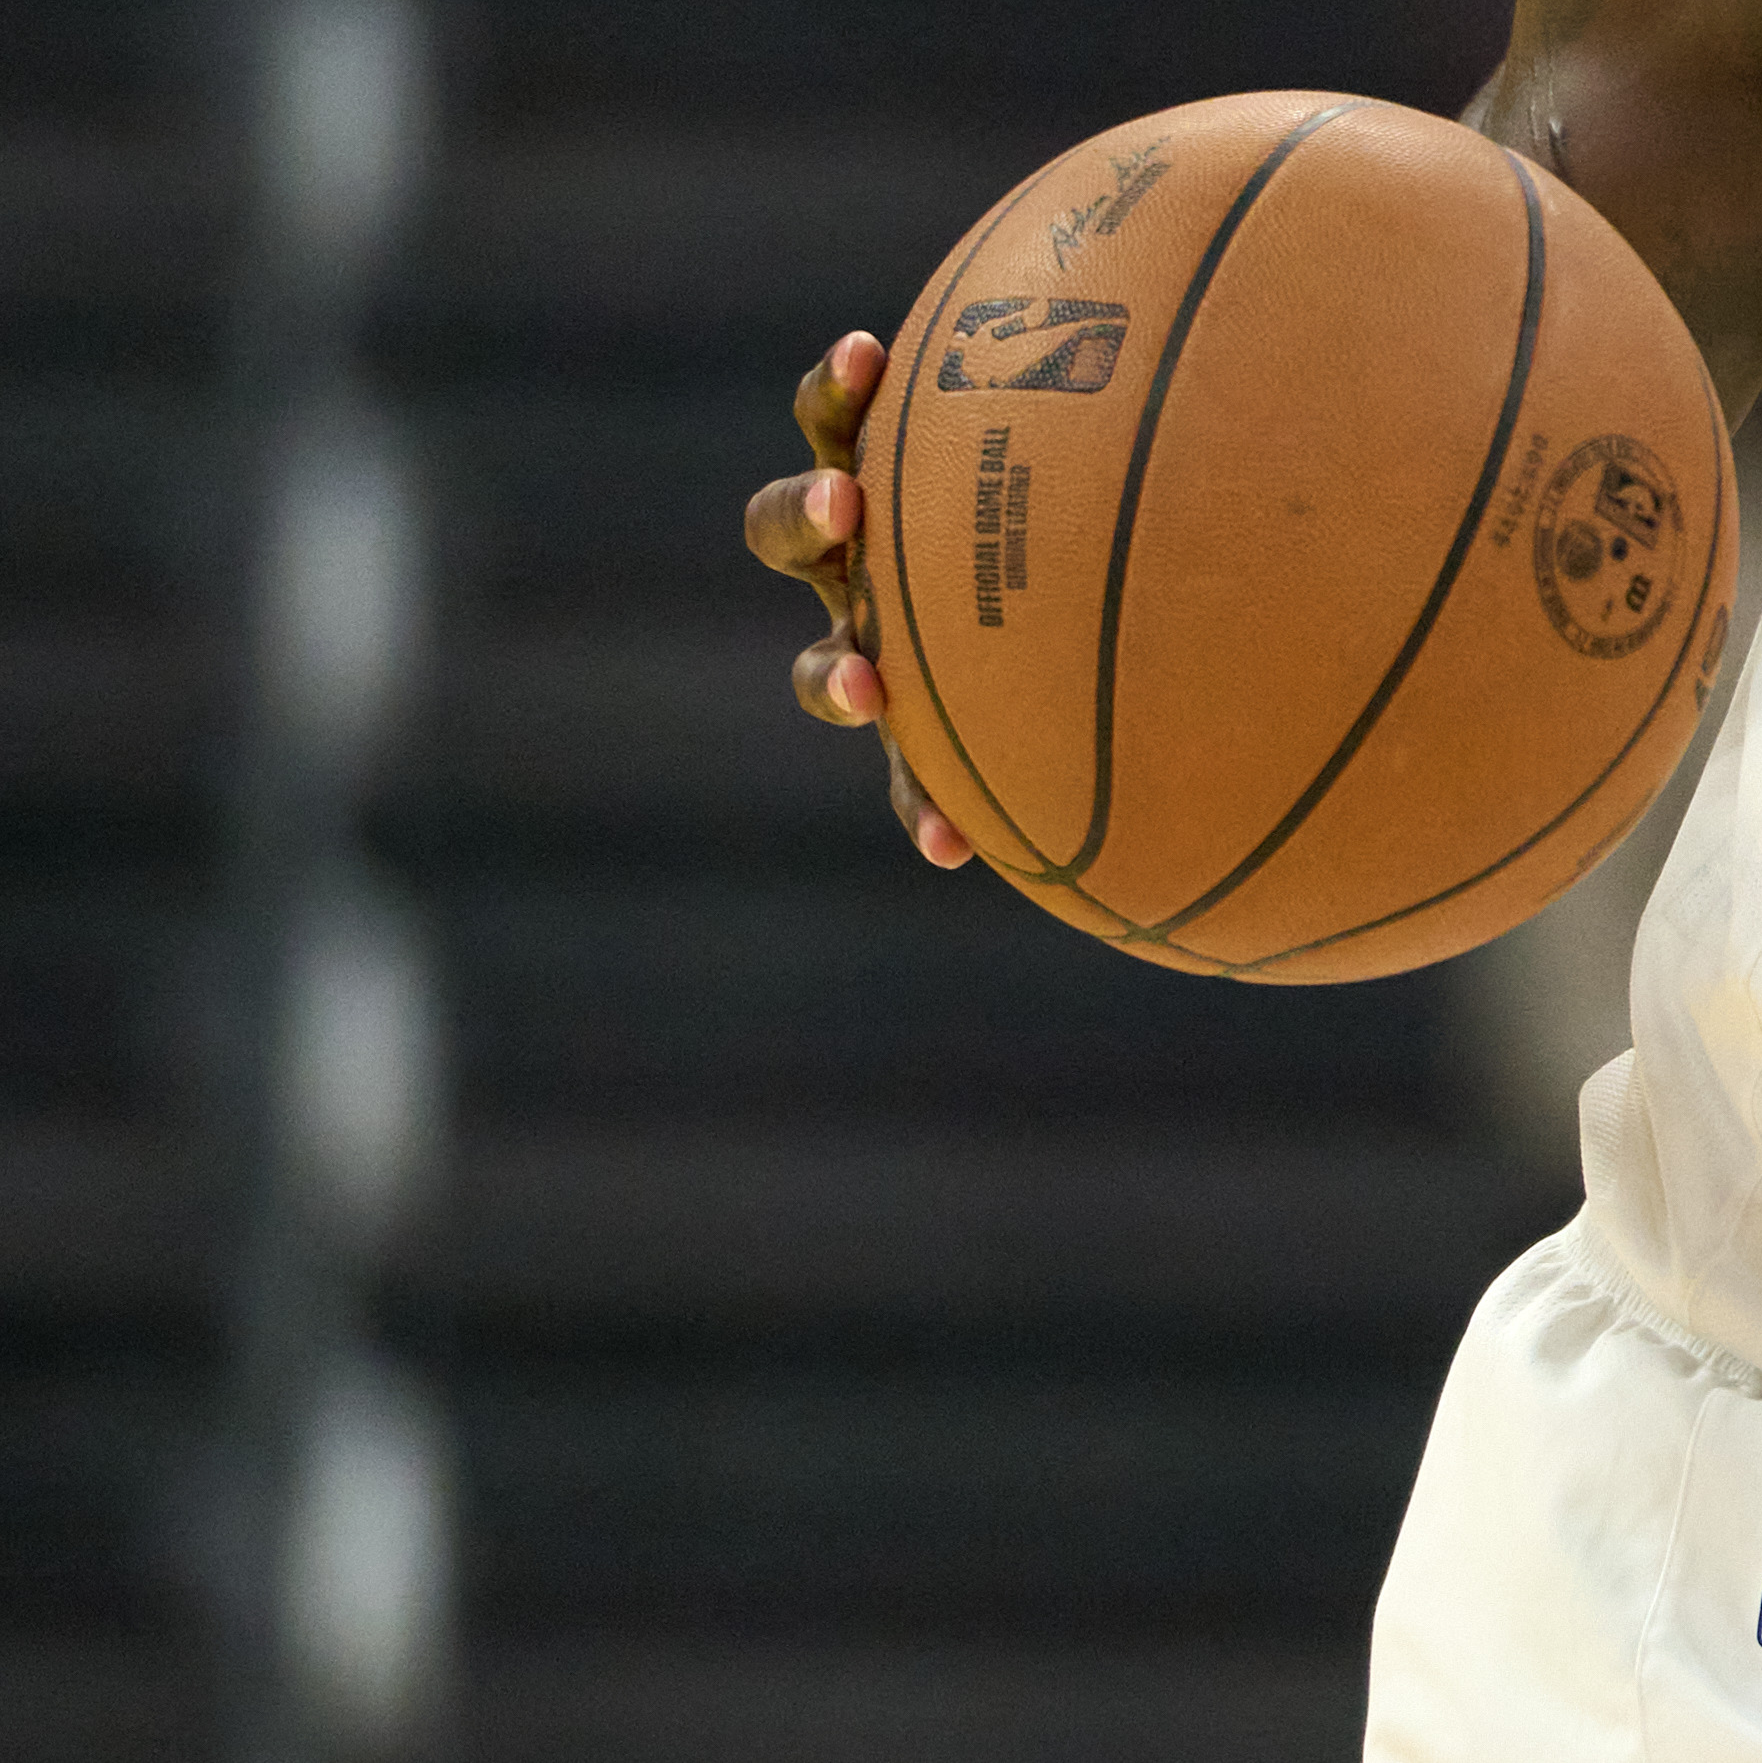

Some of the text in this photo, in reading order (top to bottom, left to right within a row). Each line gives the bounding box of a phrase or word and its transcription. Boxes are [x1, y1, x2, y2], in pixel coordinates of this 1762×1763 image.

[974, 425, 1011, 627] OFFICIAL GAME BALL
